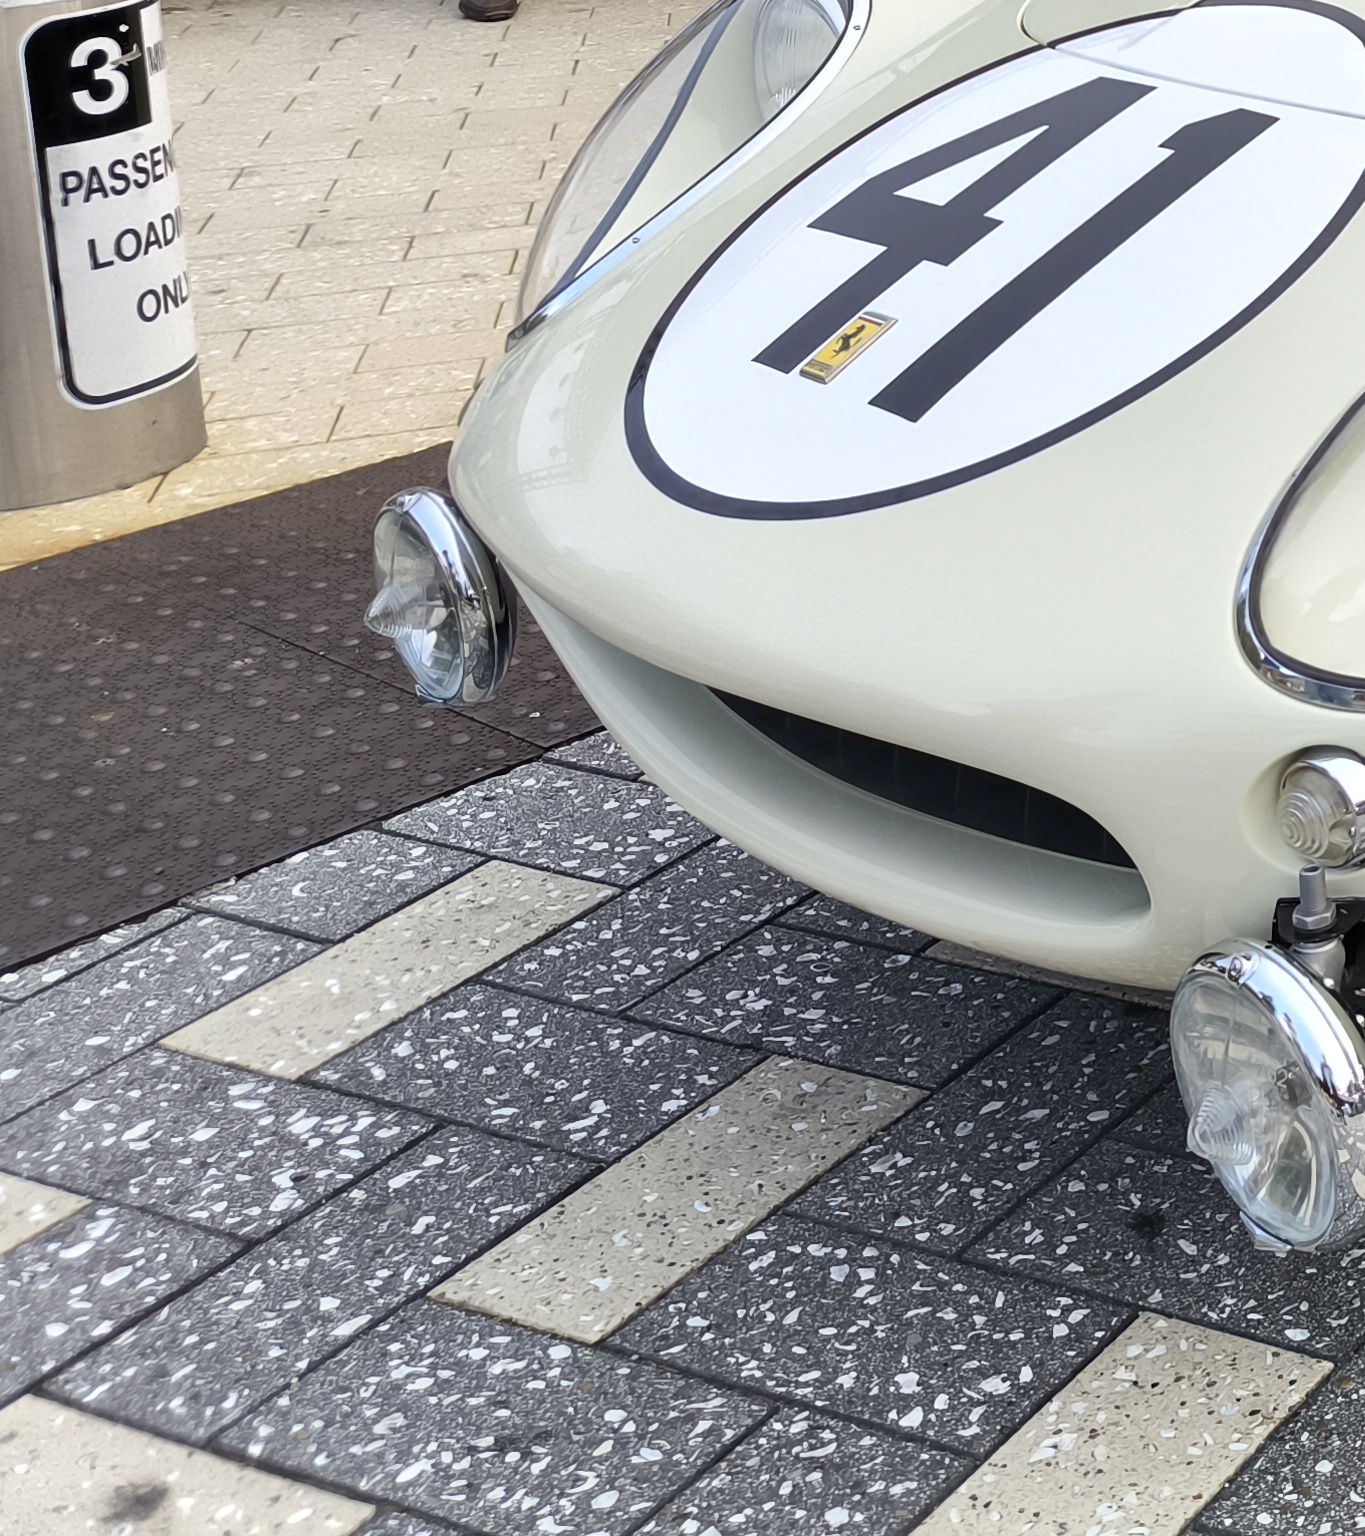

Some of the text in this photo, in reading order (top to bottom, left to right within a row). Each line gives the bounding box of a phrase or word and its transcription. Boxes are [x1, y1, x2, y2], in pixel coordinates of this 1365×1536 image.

[71, 36, 130, 115] 3
[59, 139, 176, 208] PASSEN
[750, 75, 1282, 424] 41
